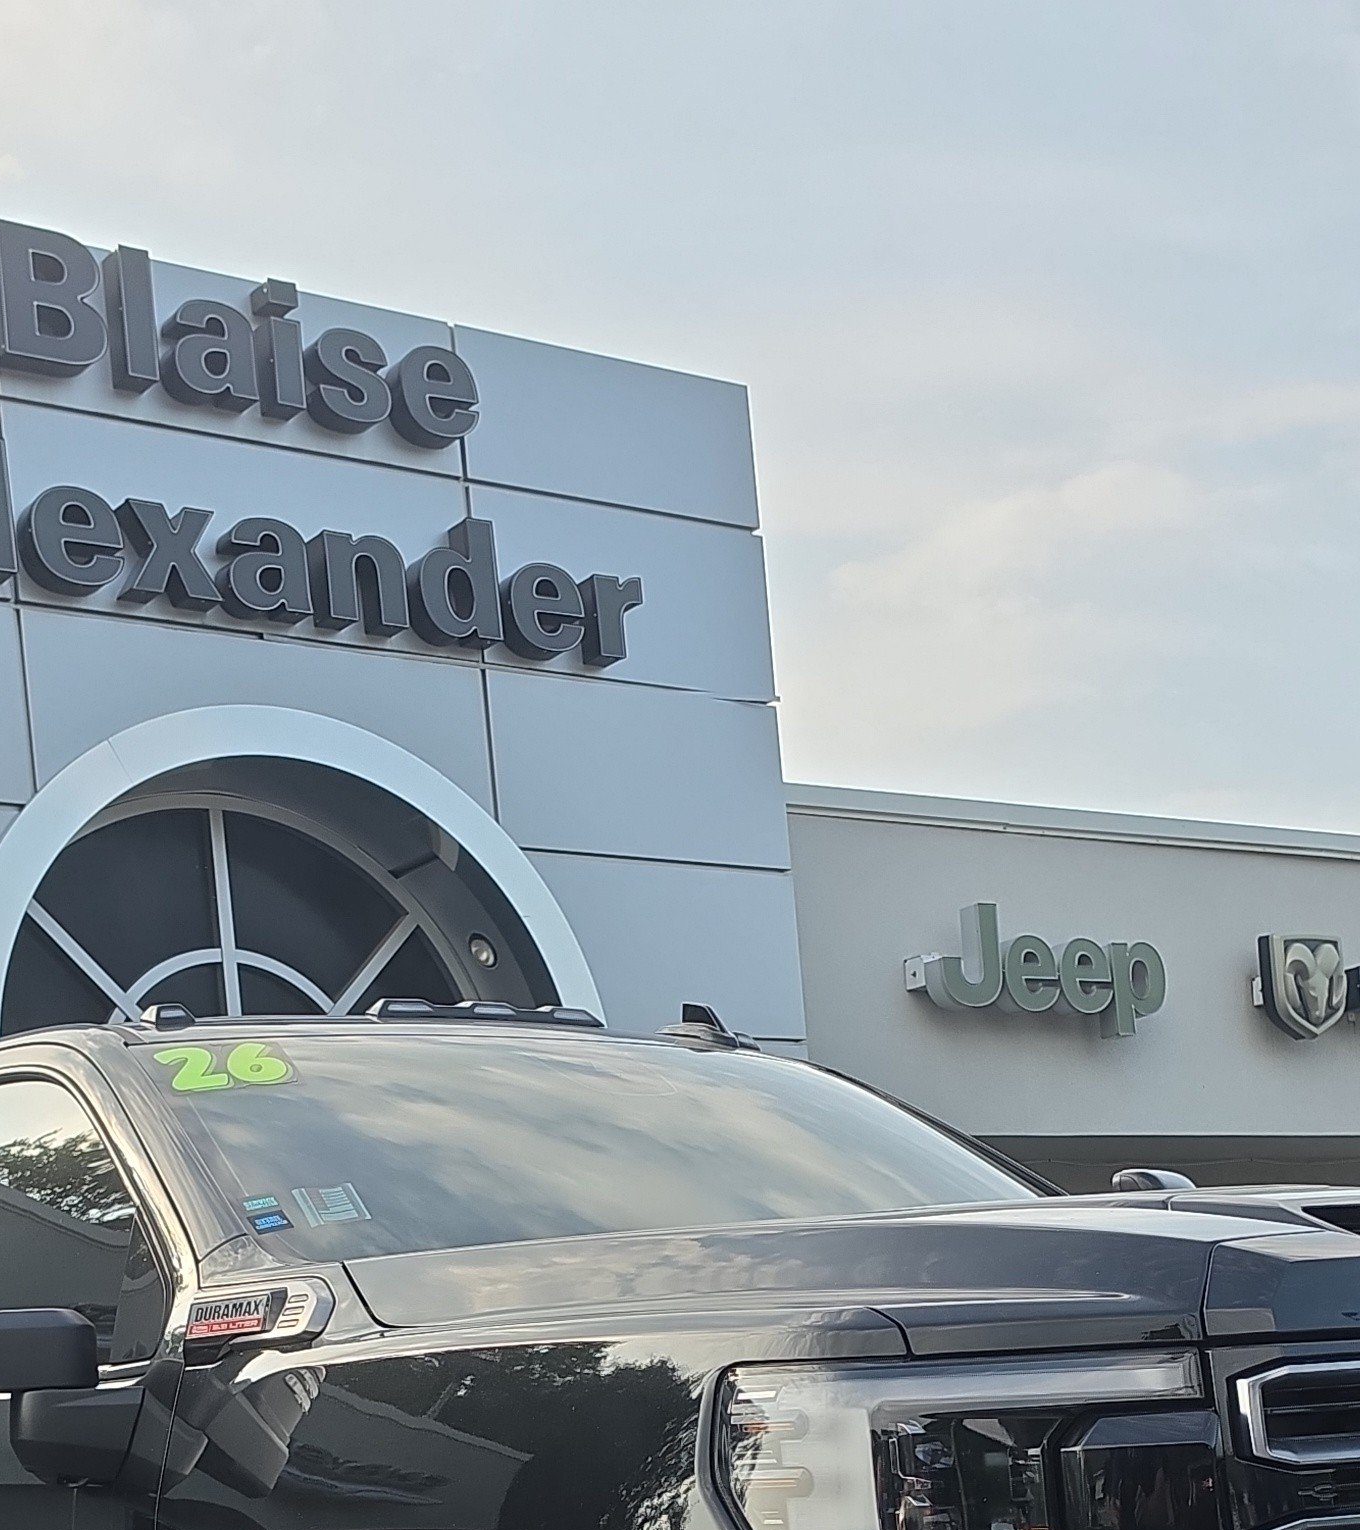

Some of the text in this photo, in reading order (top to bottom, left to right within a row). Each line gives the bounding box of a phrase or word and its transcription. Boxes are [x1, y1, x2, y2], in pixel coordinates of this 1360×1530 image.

[929, 903, 1166, 1038] Jeep
[154, 1043, 287, 1091] 26
[195, 1299, 262, 1322] DURAMAX
